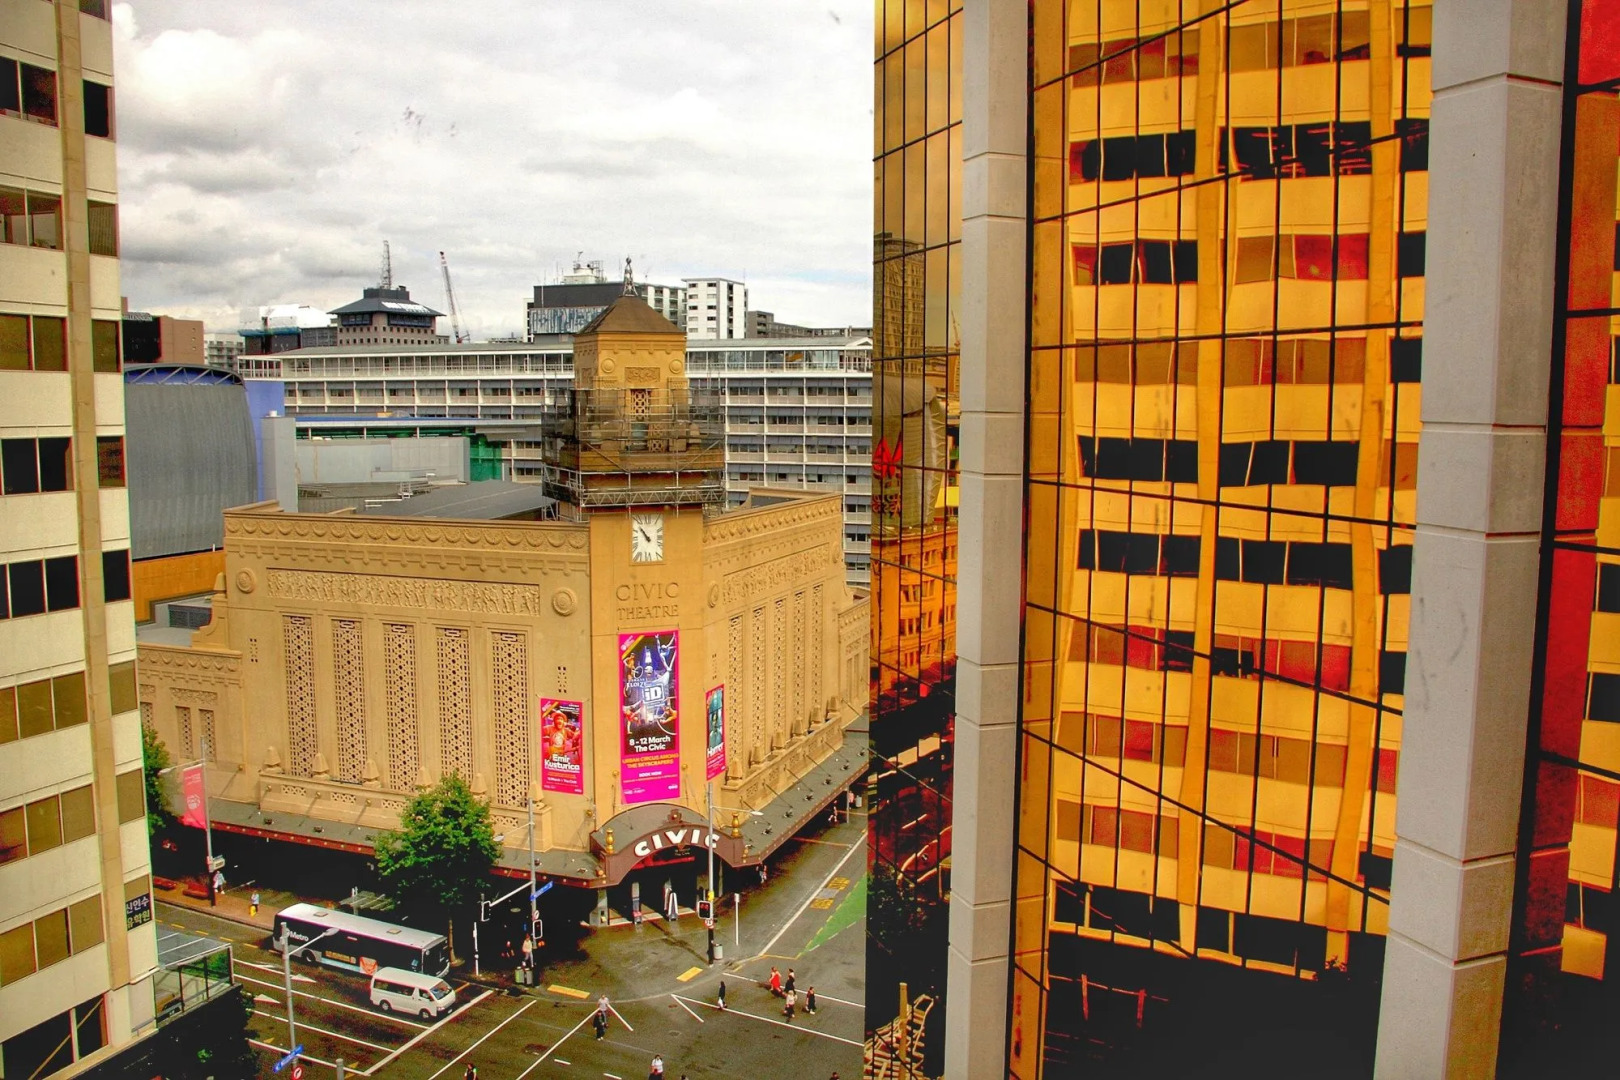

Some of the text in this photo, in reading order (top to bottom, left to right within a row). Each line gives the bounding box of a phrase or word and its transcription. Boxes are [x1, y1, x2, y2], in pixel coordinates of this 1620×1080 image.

[616, 582, 679, 601] CIVIC
[617, 605, 679, 620] THEATRE
[629, 738, 635, 746] 8
[640, 737, 648, 745] 12
[648, 735, 671, 744] March
[648, 743, 666, 751] Civic
[552, 753, 570, 763] Emir
[544, 759, 581, 771] Kusturica
[634, 829, 720, 857] CIVIC
[289, 930, 309, 942] Metro
